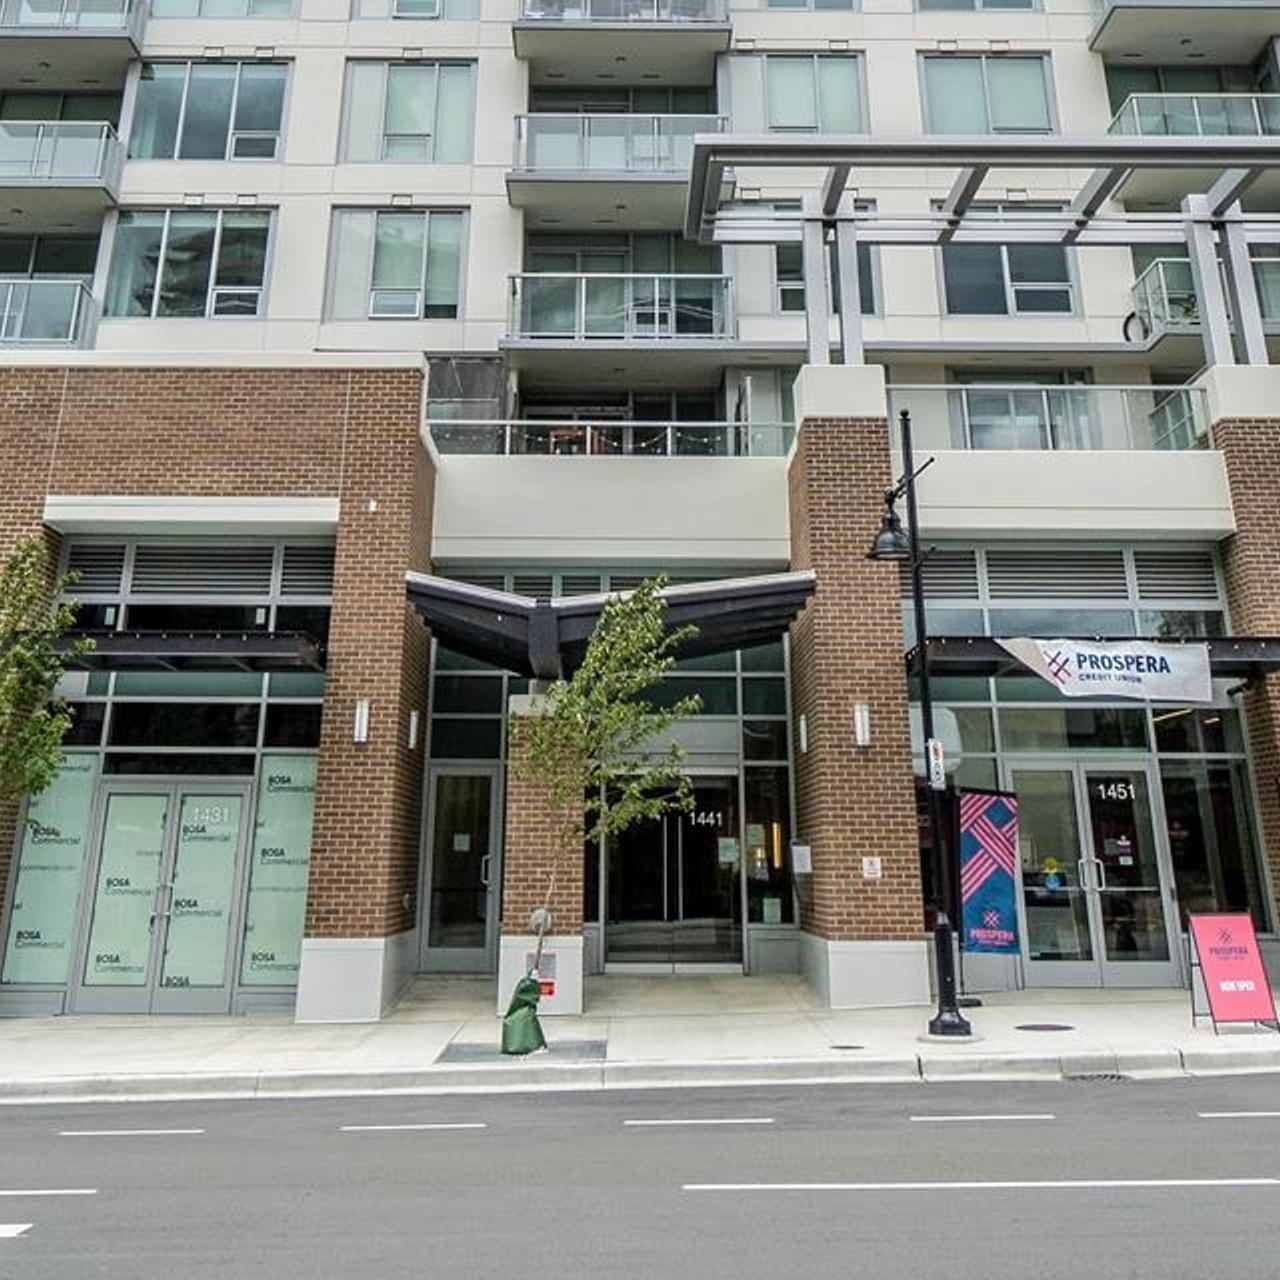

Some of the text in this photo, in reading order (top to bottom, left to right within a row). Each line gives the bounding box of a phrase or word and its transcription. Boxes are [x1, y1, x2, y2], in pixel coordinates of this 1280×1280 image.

[1076, 653, 1172, 673] PROSPERA
[1079, 673, 1142, 683] CREDIT UNION
[268, 776, 291, 784] BOSA
[1098, 783, 1136, 799] 1451
[690, 812, 722, 826] 1441
[182, 825, 207, 833] BOSA
[261, 848, 285, 857] BOSA
[106, 878, 130, 887] BOSA
[174, 899, 198, 908] BOSA
[17, 931, 41, 940] BOSA
[96, 955, 120, 964] BOSA
[252, 953, 275, 962] BOSA
